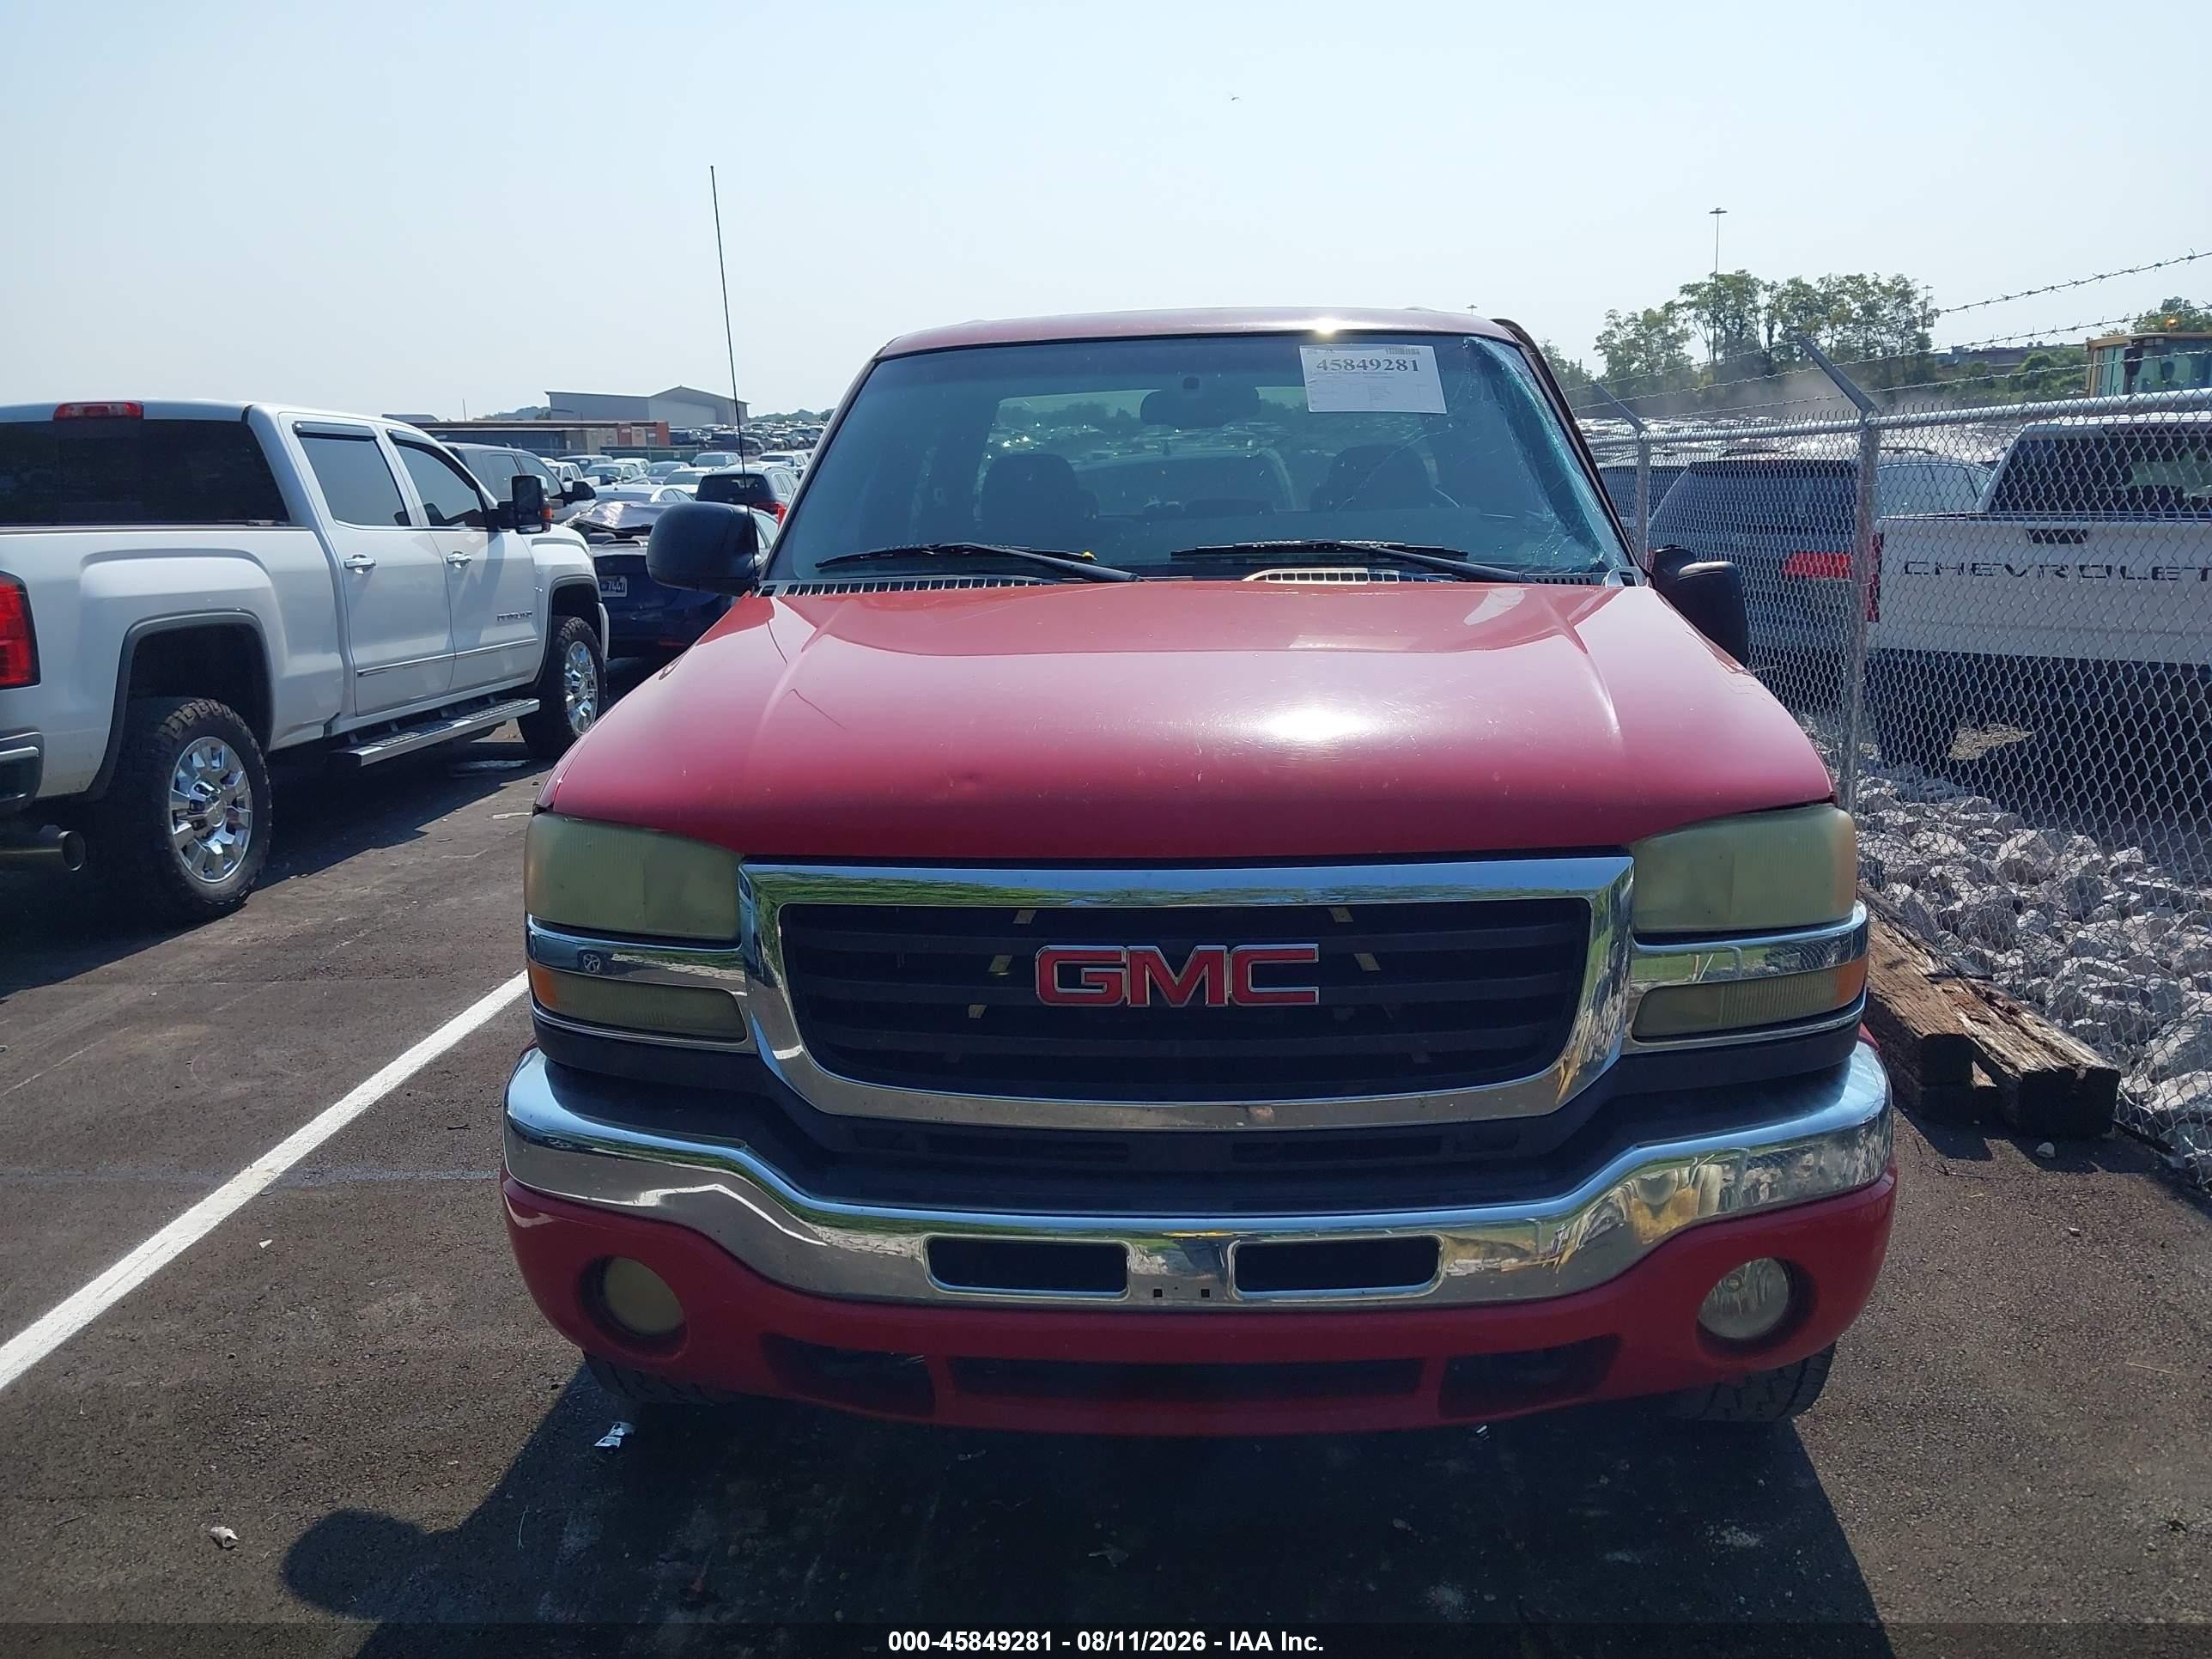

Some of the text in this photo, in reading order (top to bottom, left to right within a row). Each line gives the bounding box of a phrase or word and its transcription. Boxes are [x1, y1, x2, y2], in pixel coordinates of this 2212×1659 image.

[1316, 358, 1419, 372] 45849281
[1904, 561, 2212, 581] CHEVROLET
[1036, 943, 1320, 1008] GMC
